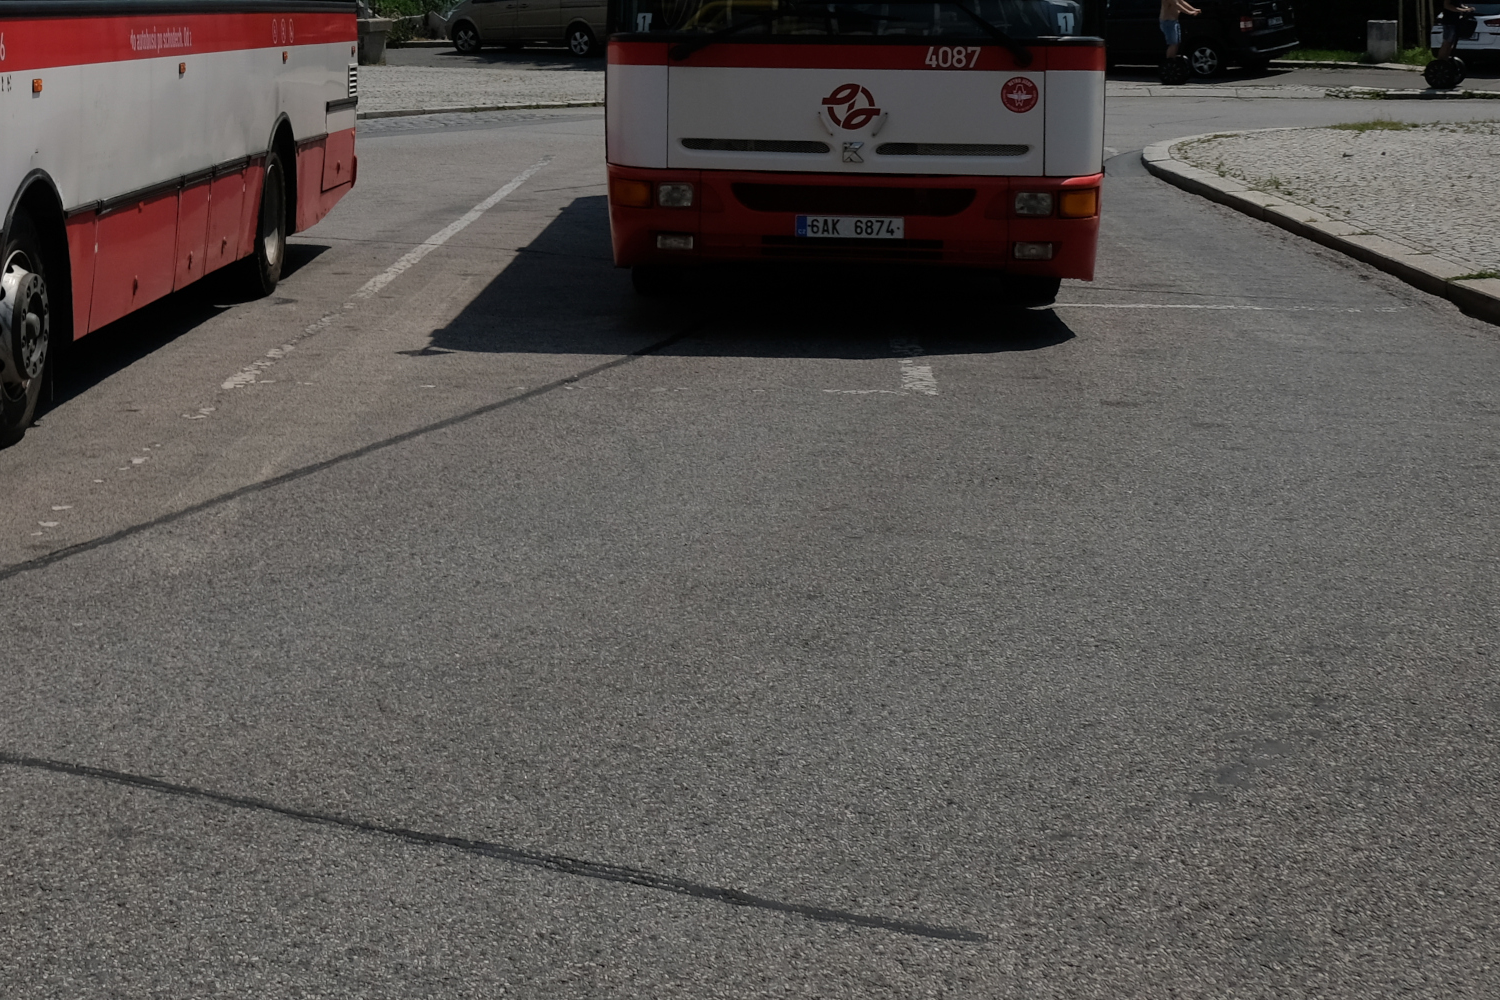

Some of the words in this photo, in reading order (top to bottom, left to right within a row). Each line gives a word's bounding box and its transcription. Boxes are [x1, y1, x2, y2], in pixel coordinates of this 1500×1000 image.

[925, 46, 981, 68] 4087
[811, 219, 840, 235] 6AK
[855, 219, 894, 236] 6874
